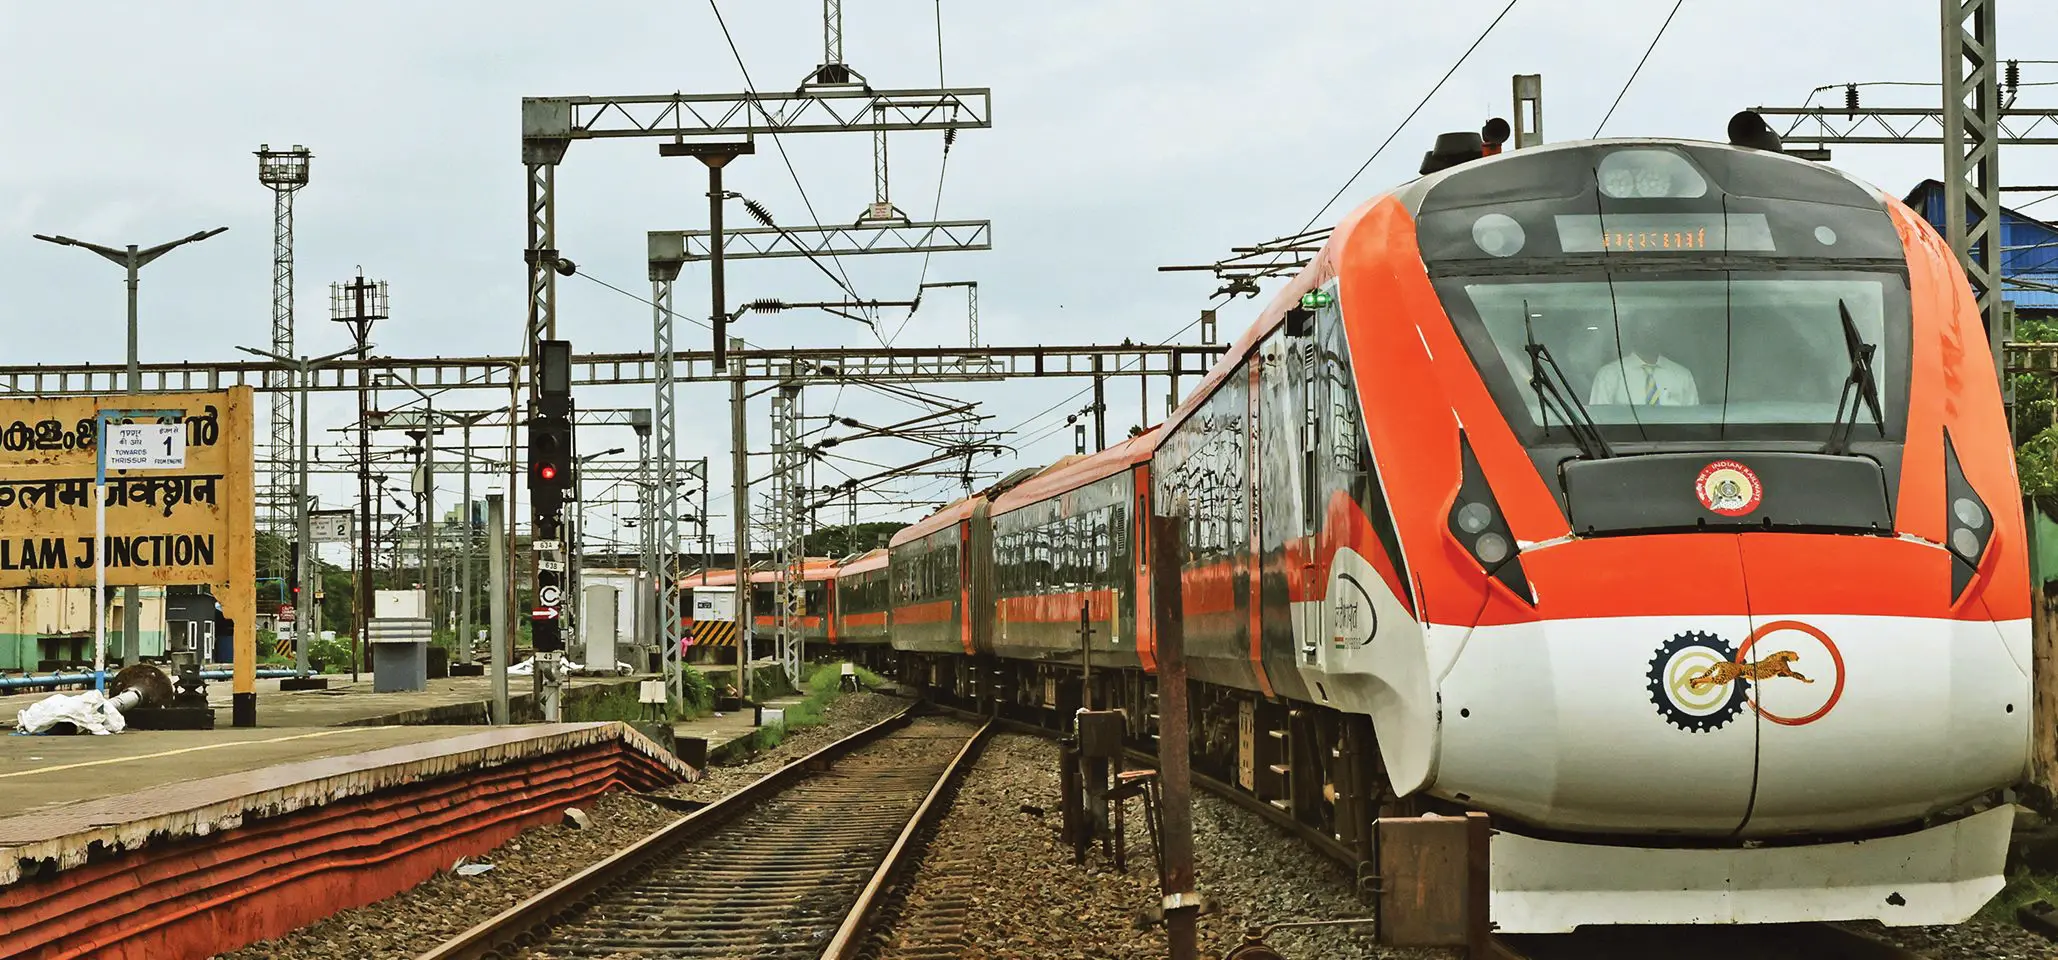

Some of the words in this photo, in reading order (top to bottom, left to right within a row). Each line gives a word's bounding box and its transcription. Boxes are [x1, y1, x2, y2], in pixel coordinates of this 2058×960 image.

[163, 436, 172, 456] 1
[1711, 461, 1743, 470] INDIAN
[1743, 468, 1761, 501] RAILWAYS
[337, 525, 346, 536] 2
[0, 538, 68, 570] LAM
